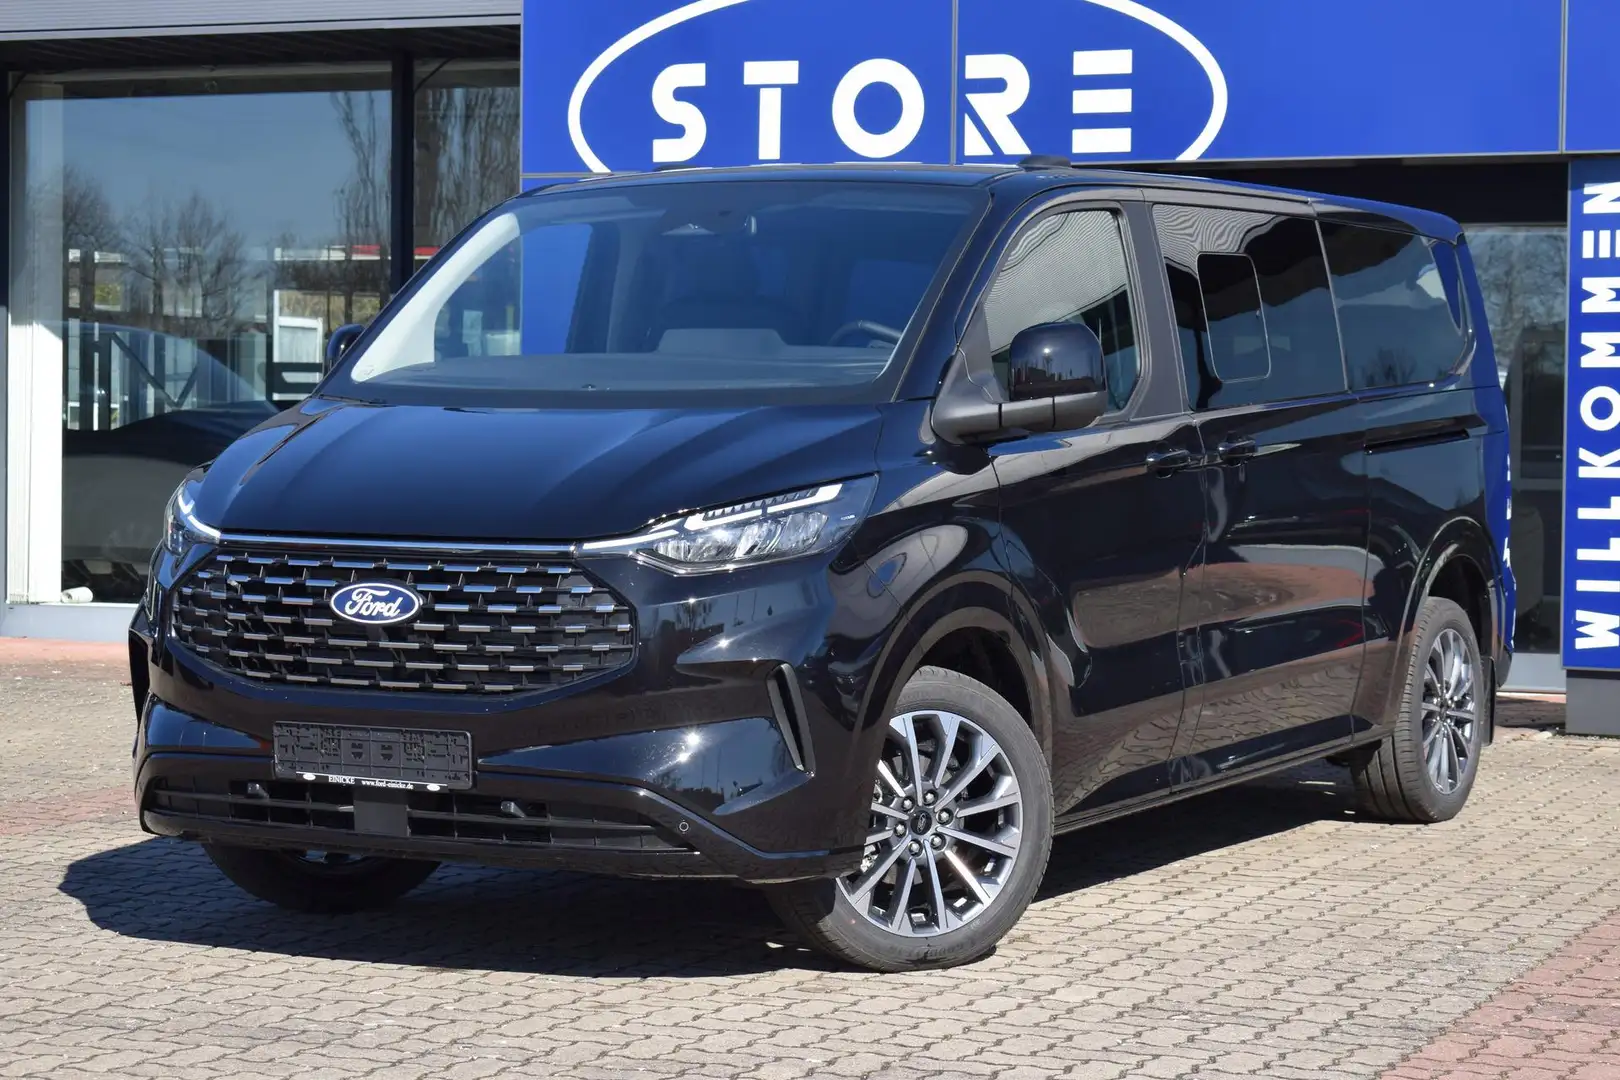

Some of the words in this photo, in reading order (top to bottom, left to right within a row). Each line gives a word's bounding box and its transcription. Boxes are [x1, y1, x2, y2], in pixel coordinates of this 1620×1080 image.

[651, 49, 1133, 163] STORE
[1574, 182, 1620, 650] WILLKOMMEN
[345, 588, 403, 617] Ford
[328, 775, 355, 785] EINICKE
